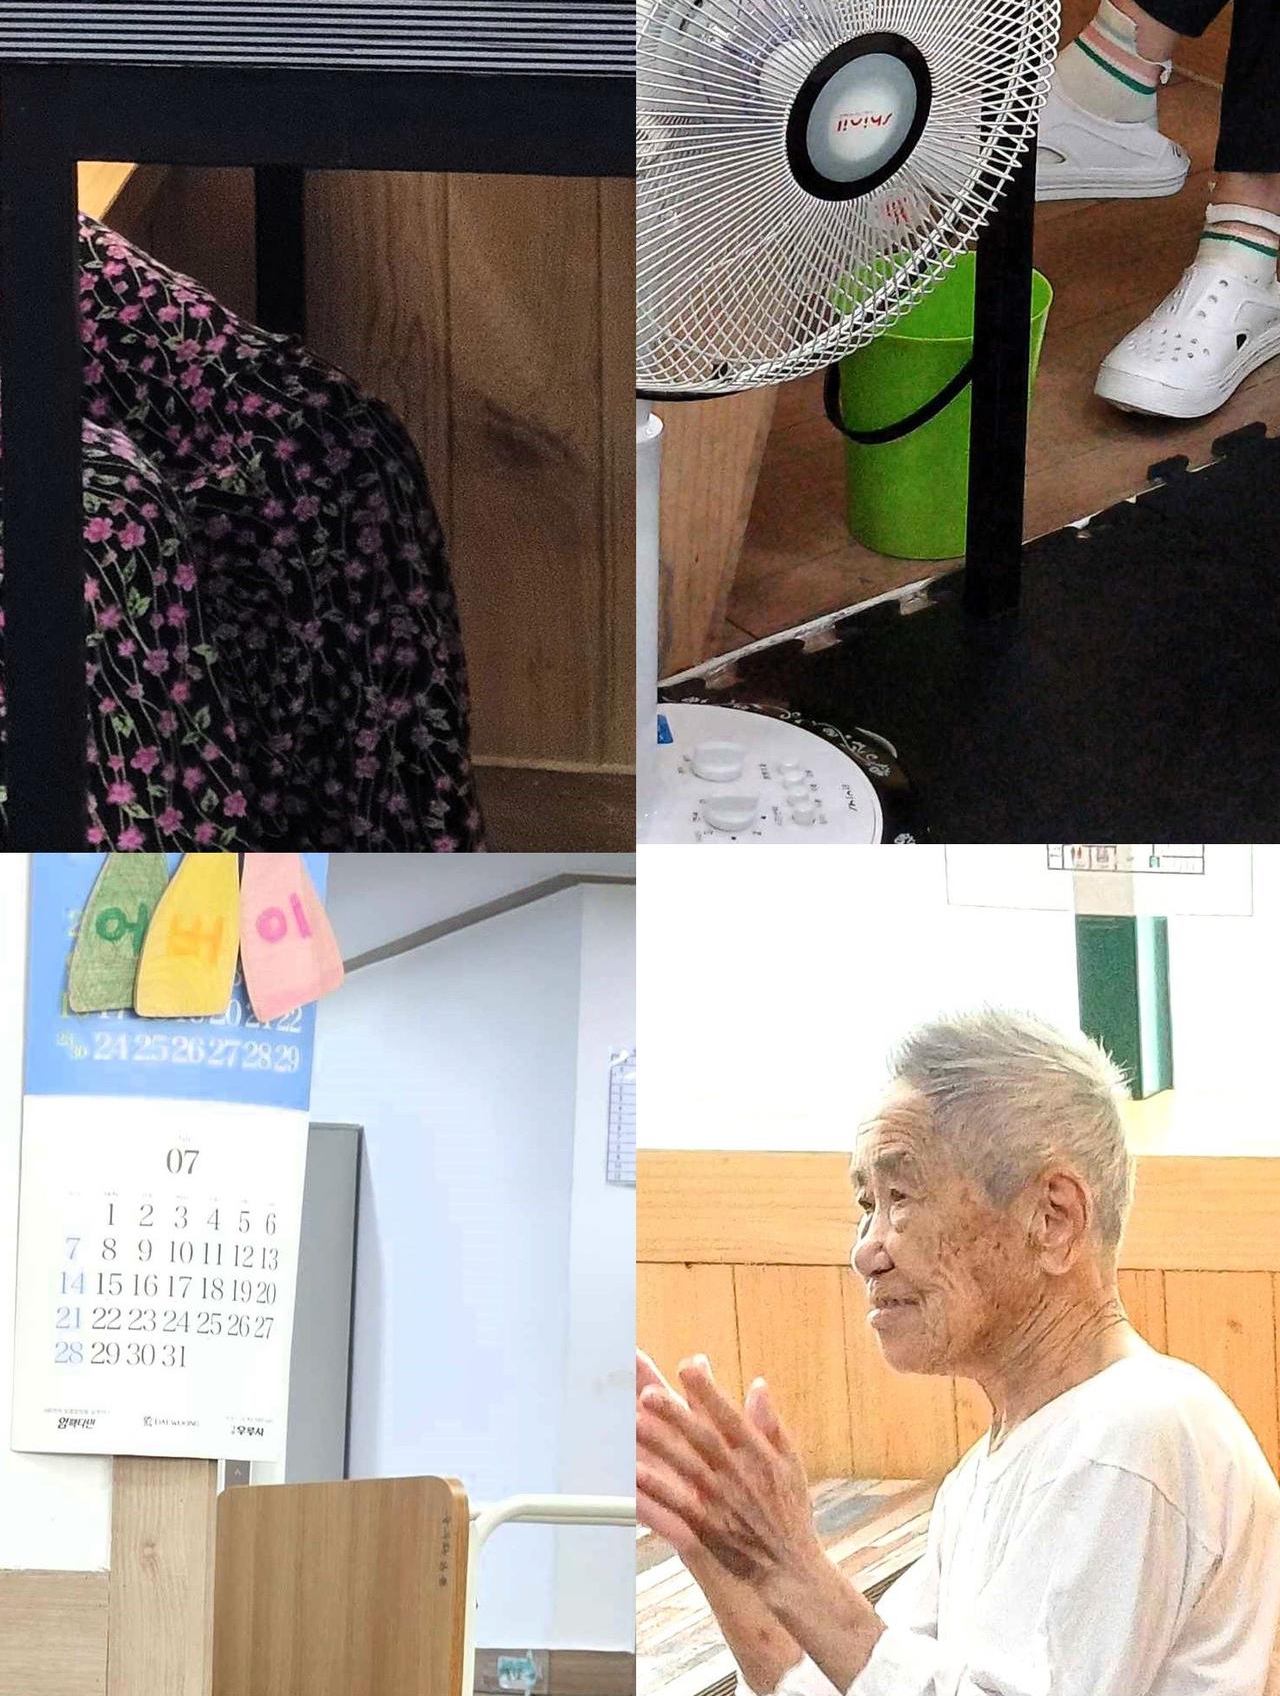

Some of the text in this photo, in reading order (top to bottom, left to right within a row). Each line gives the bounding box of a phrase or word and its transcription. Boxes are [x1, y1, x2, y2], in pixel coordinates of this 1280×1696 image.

[837, 113, 893, 132] shinil
[92, 1031, 128, 1061] 24
[132, 1033, 168, 1062] 25
[171, 1035, 205, 1064] 26
[208, 1038, 241, 1068] 27
[242, 1041, 272, 1071] 28
[273, 1044, 300, 1073] 29
[165, 1147, 201, 1176] 07
[108, 1202, 277, 1236] 1 2 3 4 5 6
[65, 1236, 279, 1271] 7 8 9 10 11 12 13
[60, 1270, 277, 1305] 14 15 16 17 18 19 20
[55, 1306, 275, 1340] 21 22 23 24 25 26 27
[53, 1340, 188, 1368] 28 29 30 31
